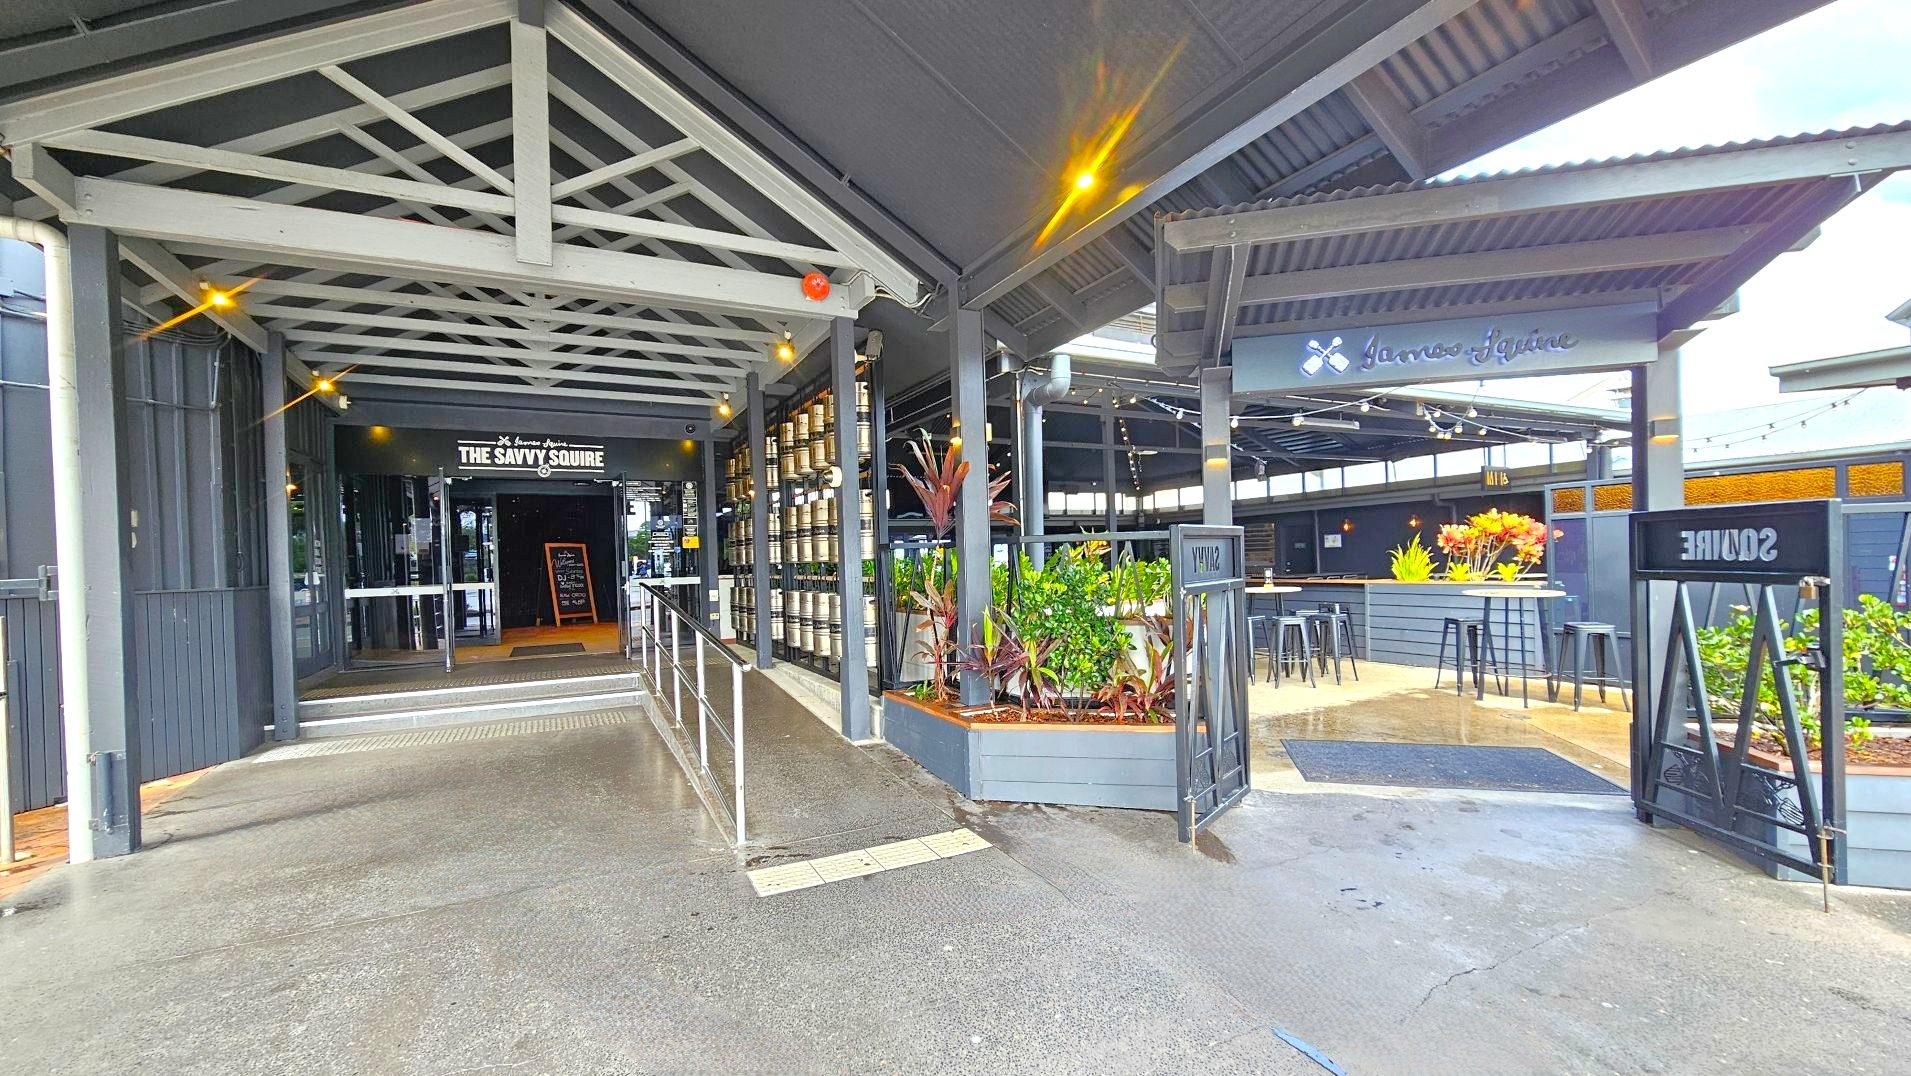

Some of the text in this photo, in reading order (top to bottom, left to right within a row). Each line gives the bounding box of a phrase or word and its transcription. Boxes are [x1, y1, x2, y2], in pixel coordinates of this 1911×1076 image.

[1361, 327, 1579, 370] James Squire
[458, 446, 605, 467] THE SAVVY SQUIRE
